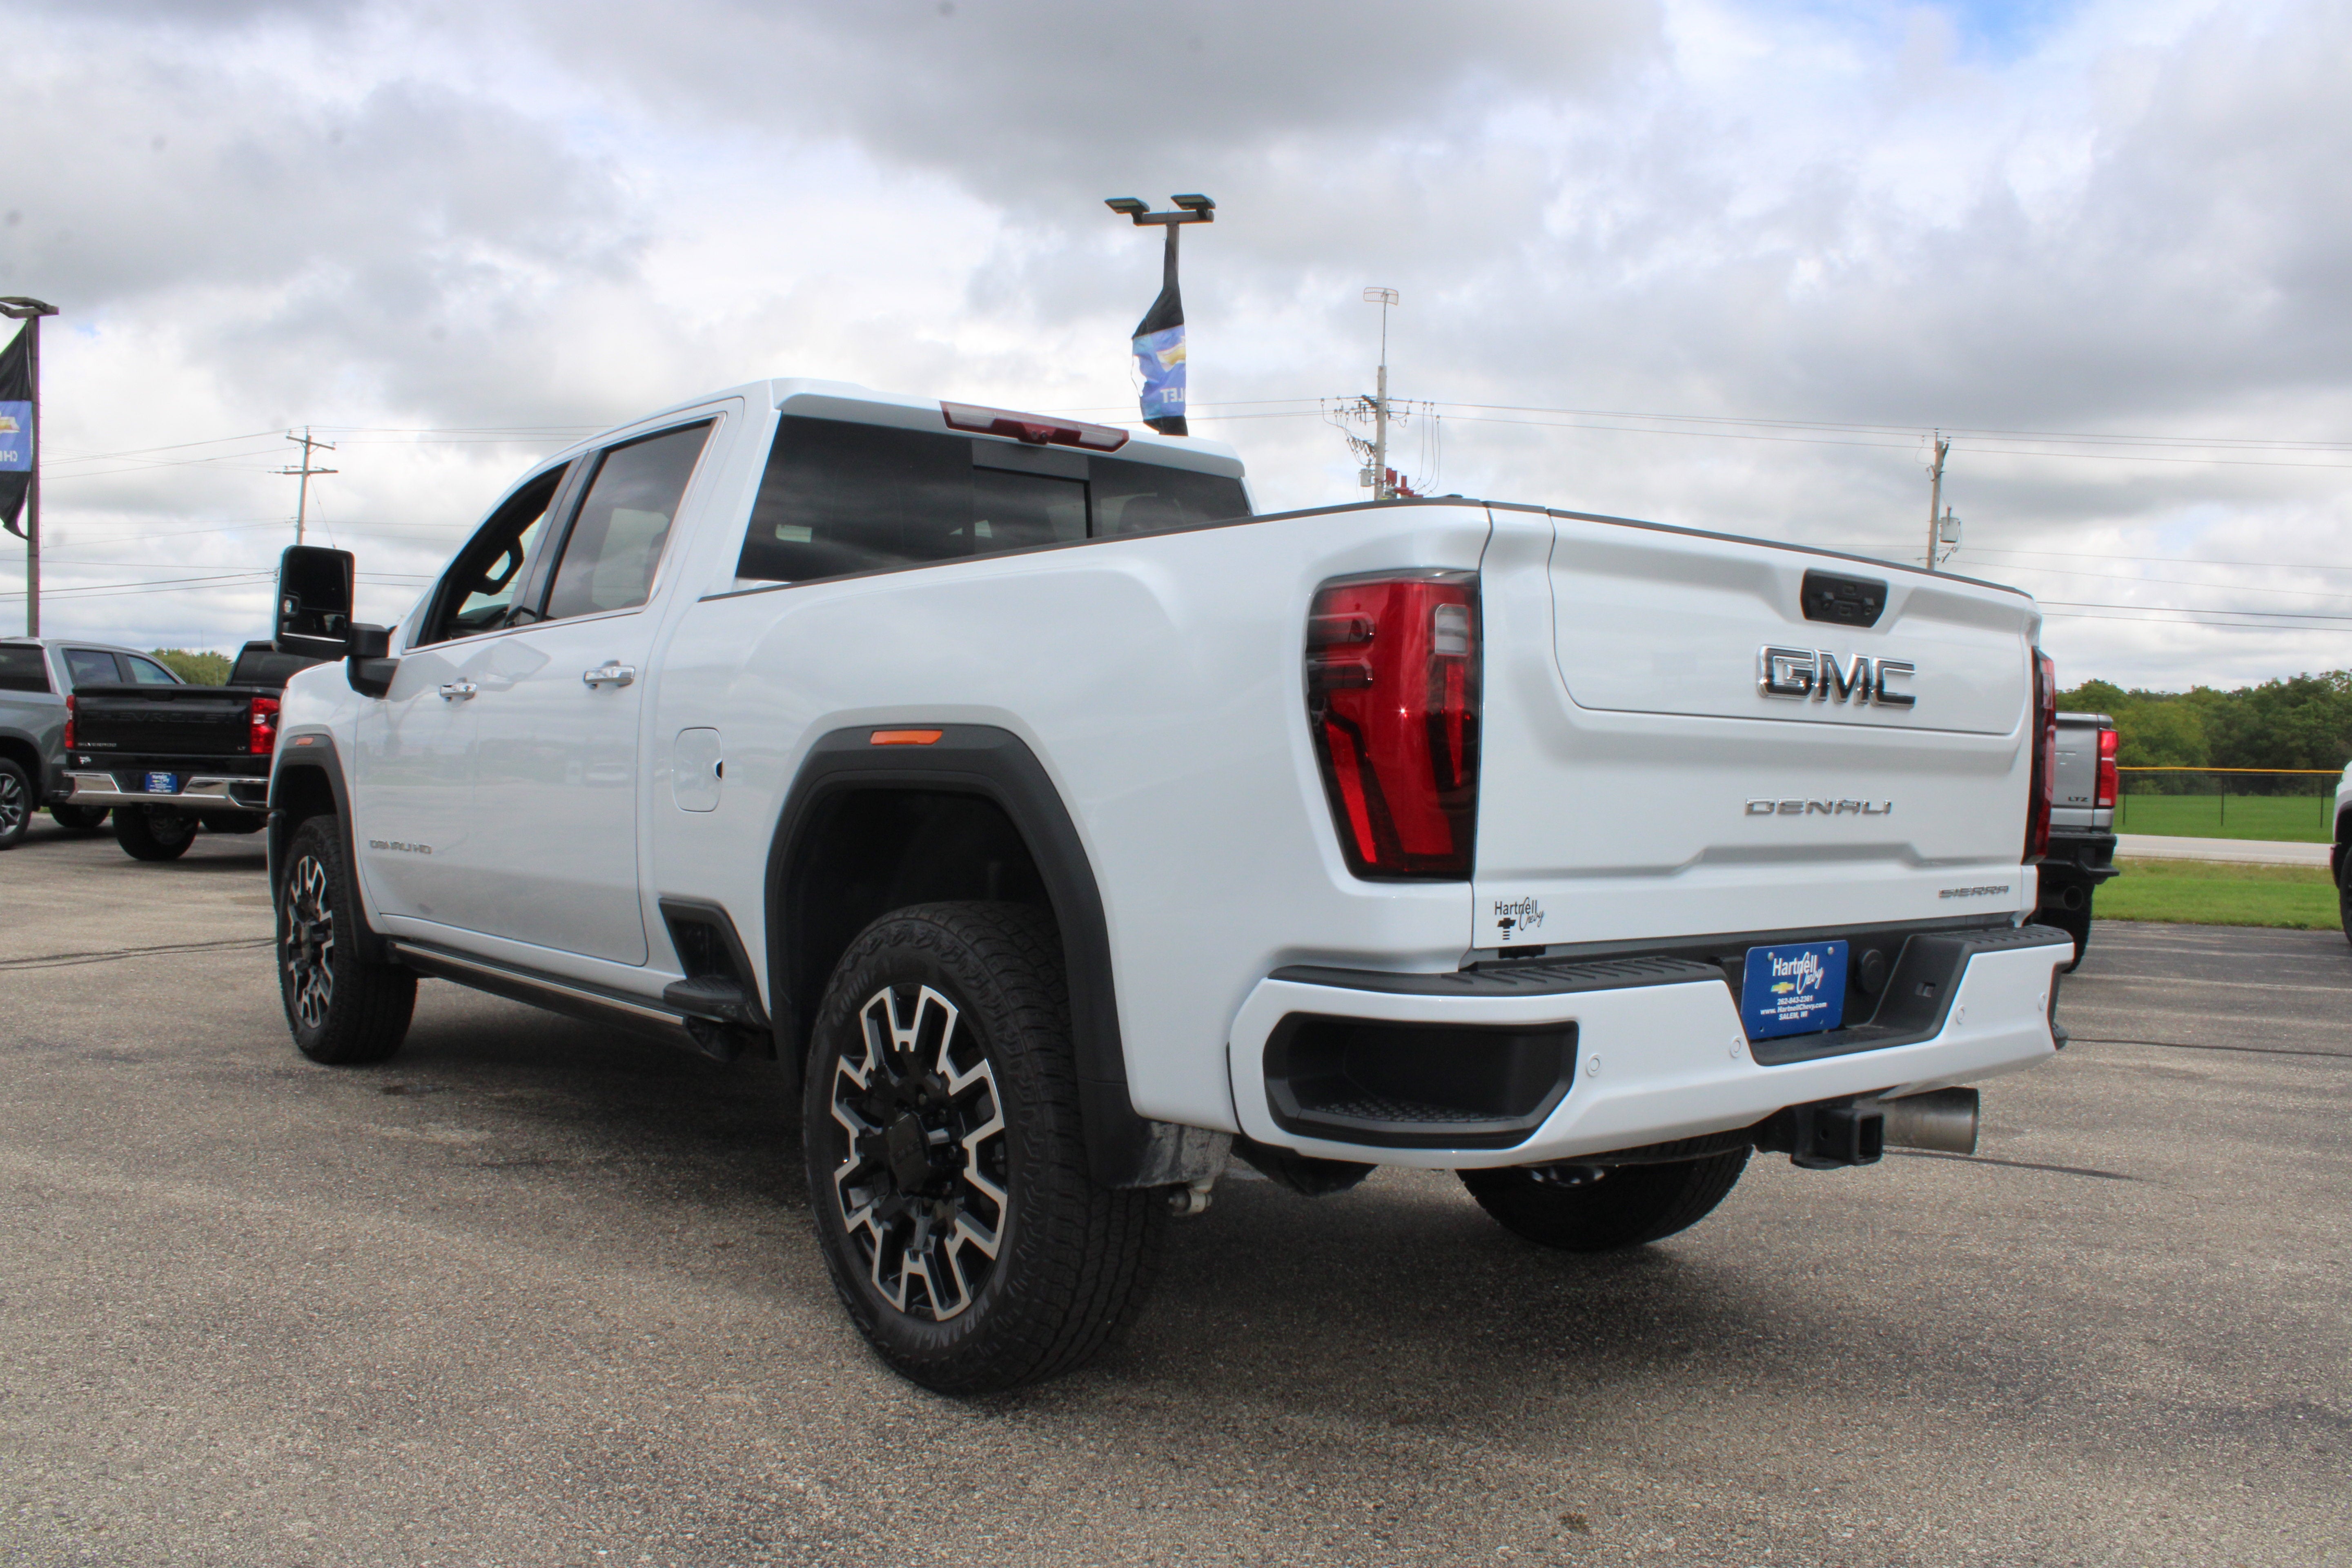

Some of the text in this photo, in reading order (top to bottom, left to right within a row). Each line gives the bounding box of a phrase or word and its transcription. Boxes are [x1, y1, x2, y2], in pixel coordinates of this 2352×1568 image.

[1757, 644, 1916, 710] GMC
[1745, 797, 1891, 815] DENALI
[1939, 885, 2009, 898] SIERRA
[1494, 900, 1537, 915] Hartnell
[1772, 954, 1818, 976] Hartnell
[1797, 951, 1824, 995] Chevy
